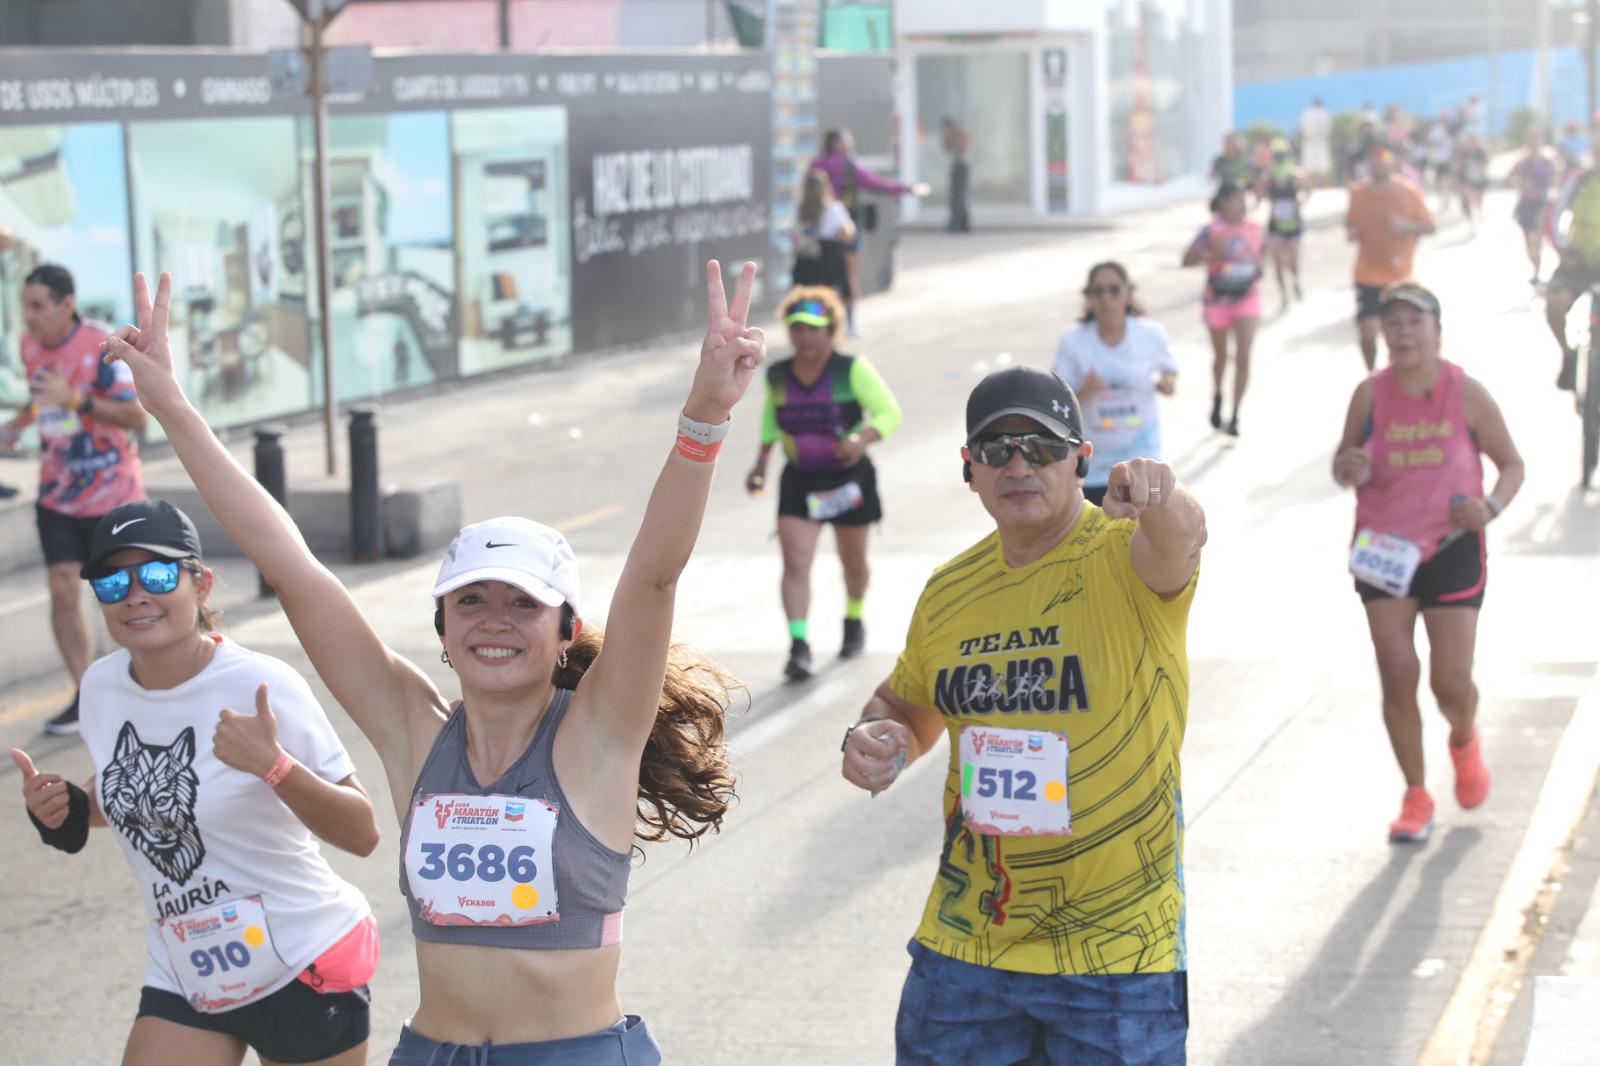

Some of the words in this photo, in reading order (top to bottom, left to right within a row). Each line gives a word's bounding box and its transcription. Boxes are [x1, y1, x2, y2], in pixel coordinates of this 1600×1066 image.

[959, 624, 1060, 657] TEAM
[934, 654, 1090, 718] MOJICA
[977, 767, 1037, 801] 512
[418, 842, 538, 884] 3686
[153, 882, 171, 900] LA
[190, 941, 251, 978] 910
